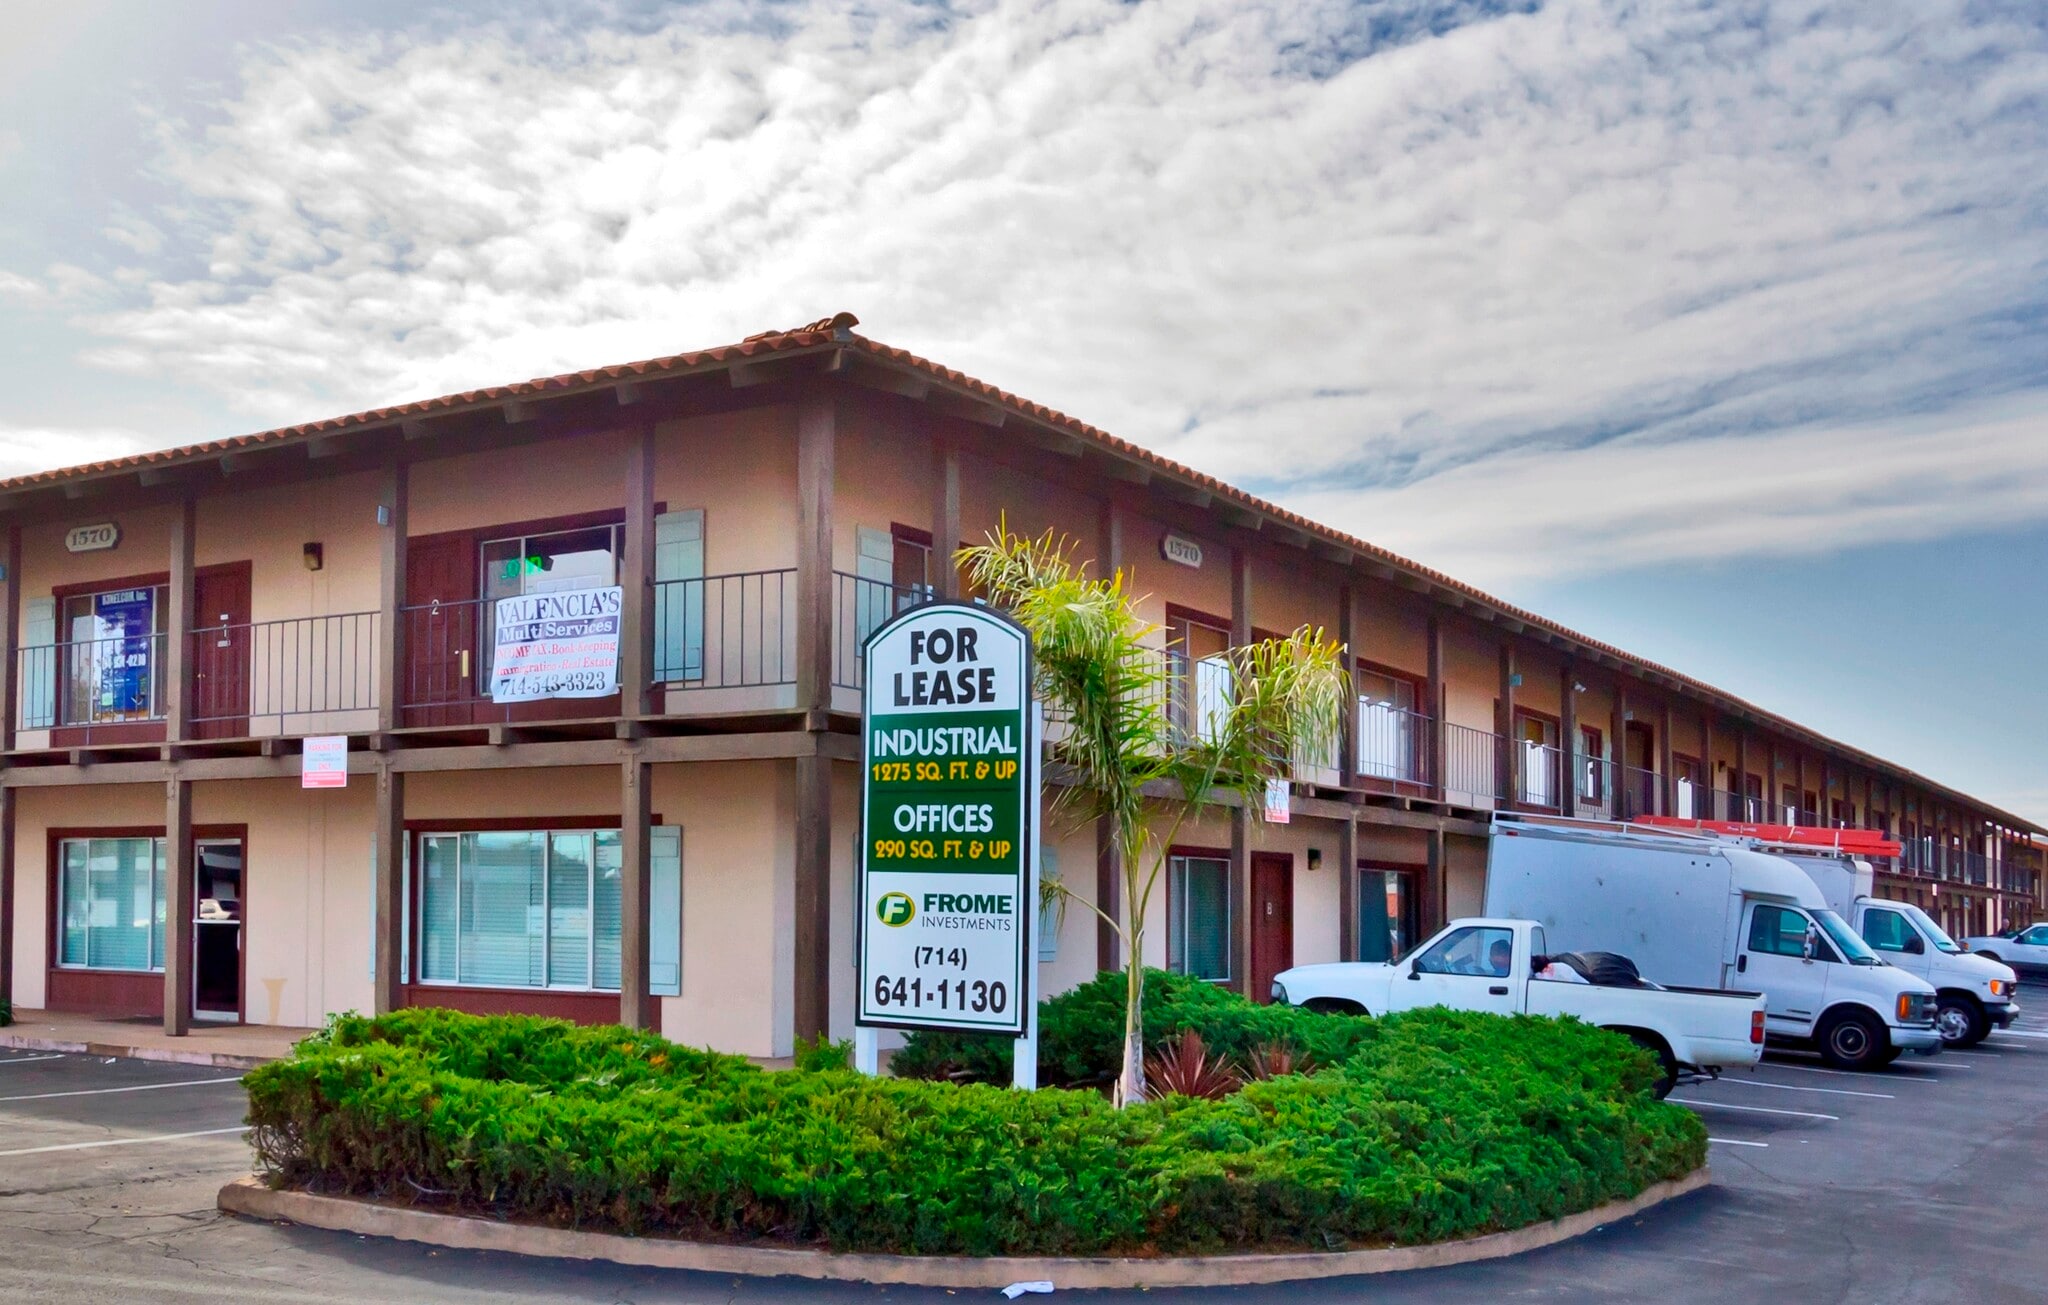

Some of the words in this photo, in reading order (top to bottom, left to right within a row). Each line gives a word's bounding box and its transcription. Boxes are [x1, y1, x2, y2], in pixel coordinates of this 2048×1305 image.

[72, 527, 112, 546] 1570
[1170, 541, 1199, 561] 1570
[432, 599, 439, 615] 2
[498, 591, 620, 625] VALENCIA'S
[502, 624, 542, 643] Multi
[545, 619, 613, 637] Services
[910, 627, 978, 666] FOR
[583, 656, 615, 668] Estate
[500, 671, 606, 696] 714-543-3323
[894, 667, 996, 707] LEASE
[874, 725, 1018, 757] INDUSTRIAL
[872, 762, 912, 781] 1275
[916, 762, 944, 781] SQ.
[950, 761, 970, 780] FT.
[975, 760, 990, 780] &
[995, 760, 1017, 779] UP
[893, 804, 994, 833] OFFICES
[875, 840, 906, 859] 290
[910, 840, 938, 859] SQ.
[943, 840, 964, 859] FT.
[969, 840, 984, 859] &
[988, 841, 1011, 859] UP
[883, 895, 907, 923] F
[924, 893, 1012, 915] FROME
[922, 915, 1011, 932] INVESTMENTS
[914, 946, 968, 971] (714)
[874, 974, 1007, 1014] 641-1130
